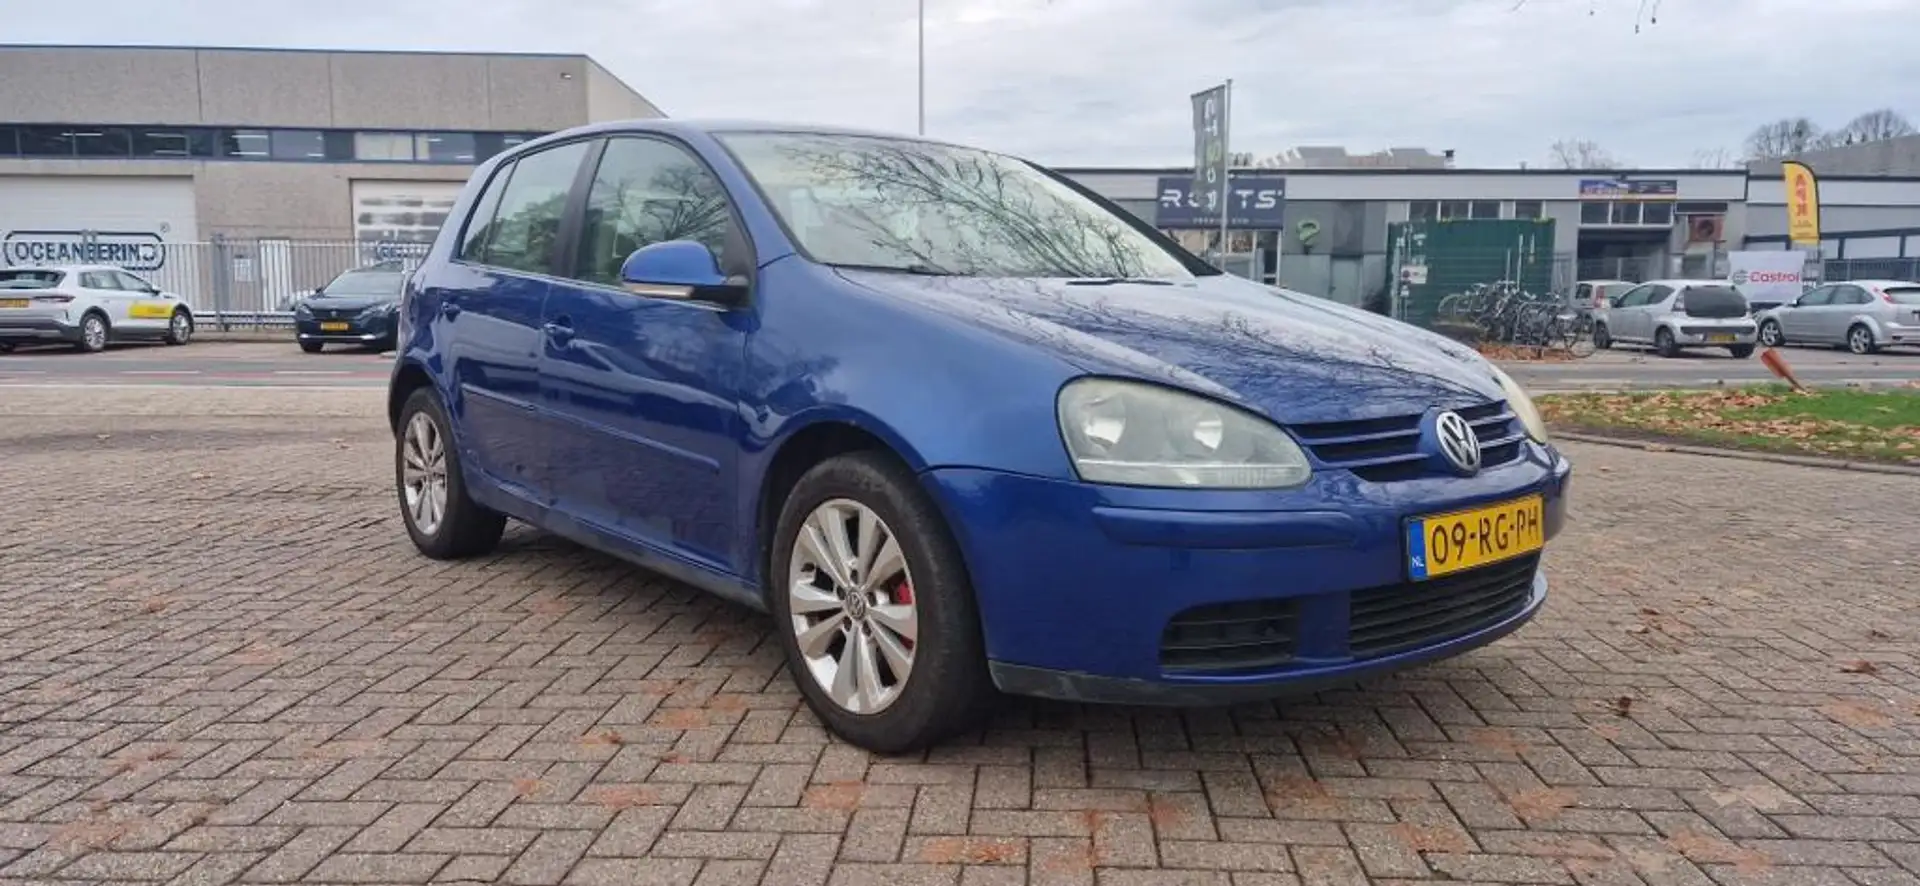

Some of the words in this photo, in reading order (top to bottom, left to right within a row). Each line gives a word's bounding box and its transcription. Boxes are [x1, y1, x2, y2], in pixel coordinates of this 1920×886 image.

[1750, 271, 1800, 283] Castrol
[1432, 507, 1539, 564] 09-RG-PH
[1412, 556, 1425, 568] NL
